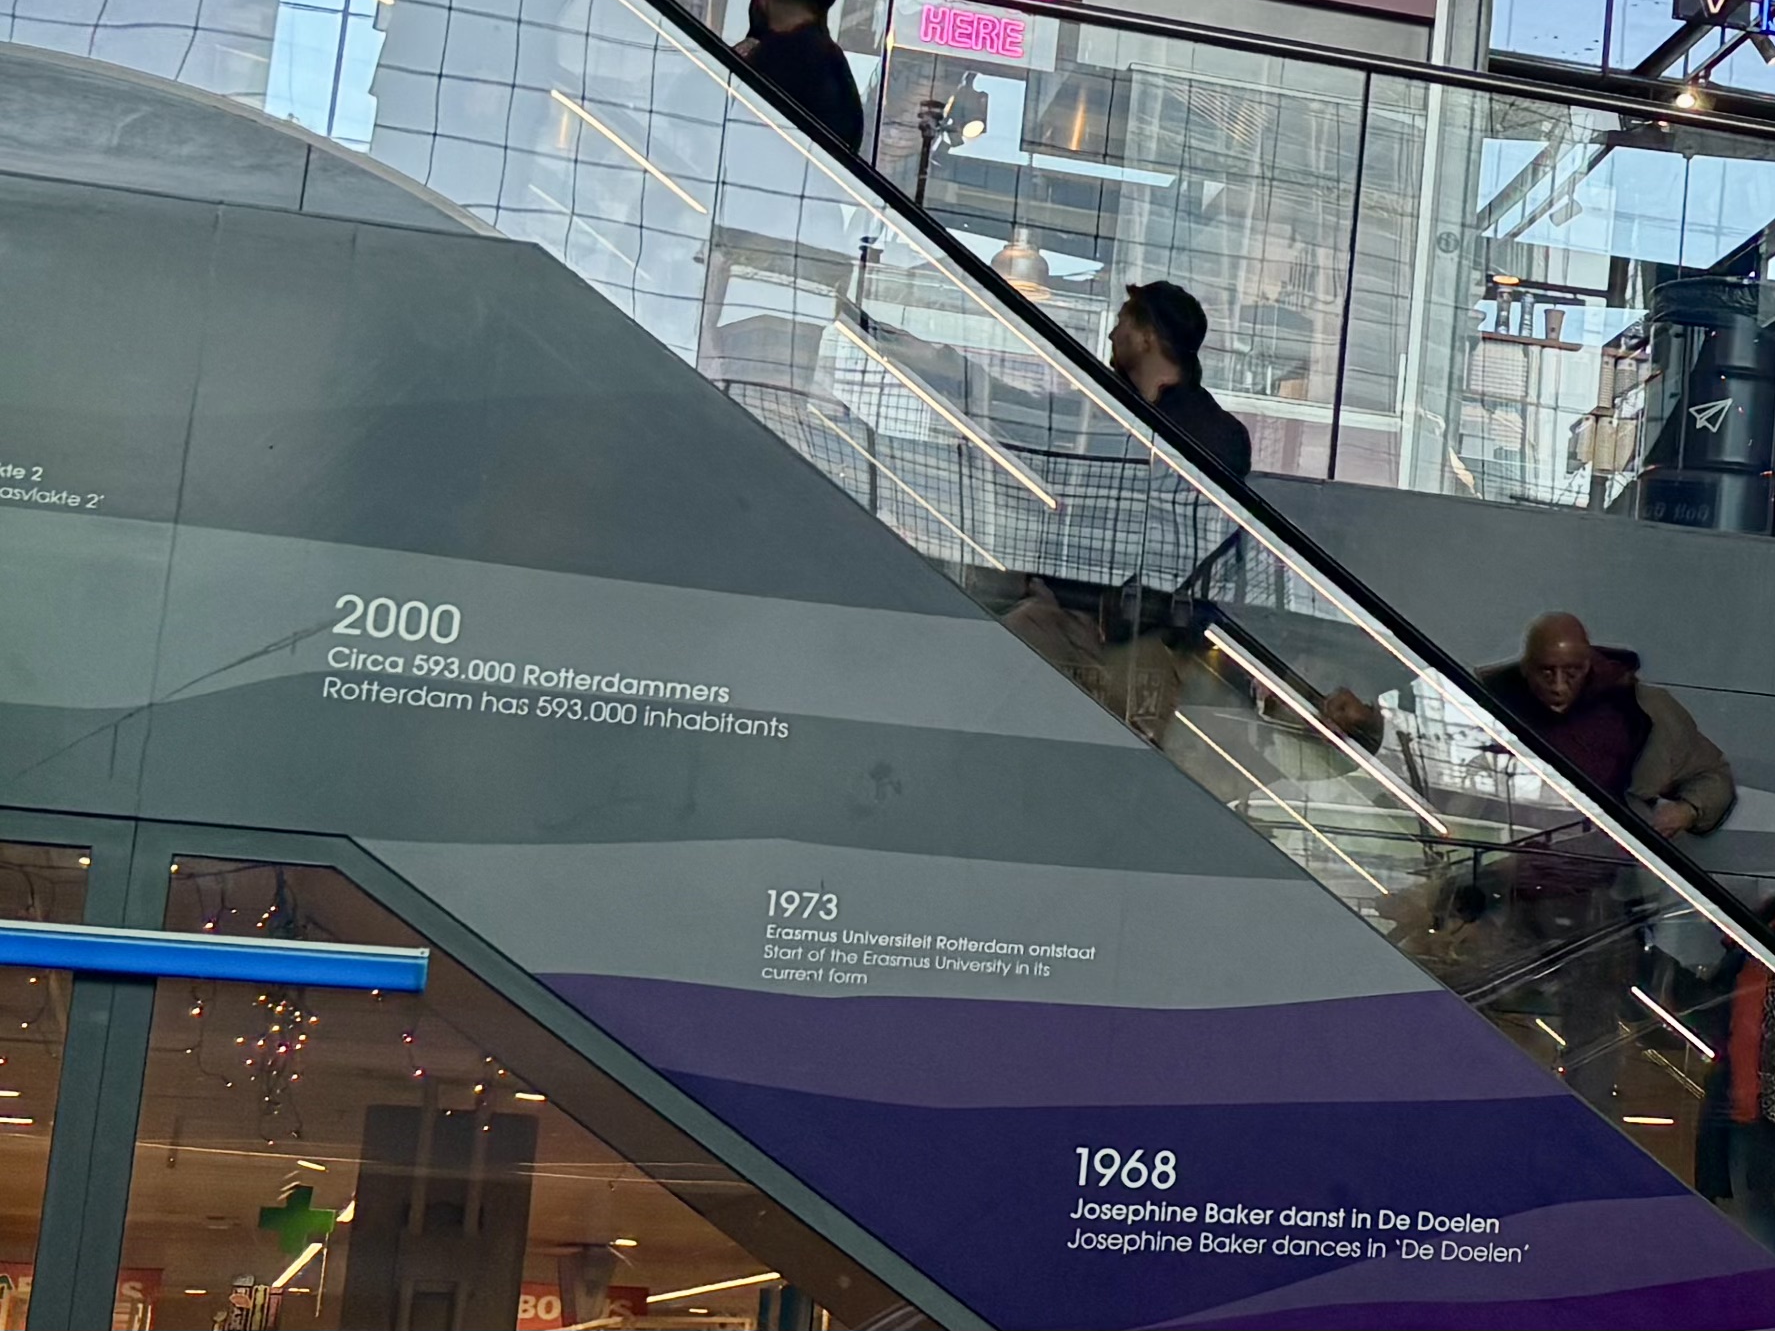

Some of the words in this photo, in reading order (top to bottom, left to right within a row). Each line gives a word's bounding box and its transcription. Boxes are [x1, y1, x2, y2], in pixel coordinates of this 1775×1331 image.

[920, 4, 1026, 59] HERE
[31, 466, 43, 481] 2
[332, 594, 461, 644] 2000
[328, 647, 404, 673] Circa
[412, 654, 516, 683] 593.000
[523, 664, 729, 703] Rotterdammers
[323, 677, 472, 710] Rotterdam
[480, 691, 529, 715] has
[536, 696, 637, 725] 593.000
[643, 705, 788, 738] inhabitants
[767, 890, 837, 920] 1973
[766, 924, 837, 943] Erasmus
[843, 929, 932, 949] Universiteit
[936, 936, 1024, 955] Rotterdam
[1029, 944, 1096, 960] ontstaat
[761, 967, 823, 982] current
[829, 968, 867, 985] form
[764, 944, 803, 960] Start
[807, 948, 827, 962] of
[831, 949, 858, 964] the
[863, 950, 930, 968] Erasmus
[935, 955, 1011, 977] University
[1015, 960, 1030, 975] in
[1034, 962, 1050, 977] its
[1076, 1147, 1176, 1190] 1968
[1070, 1198, 1198, 1225] Josephine
[1205, 1203, 1274, 1226] Baker
[1279, 1206, 1346, 1228] danst
[1351, 1208, 1371, 1229] in
[1378, 1209, 1411, 1230] De
[1417, 1211, 1499, 1234] Doelen
[1067, 1228, 1192, 1255] Josephine
[1199, 1232, 1267, 1255] Baker
[1272, 1234, 1361, 1257] dances
[1367, 1237, 1386, 1258] in
